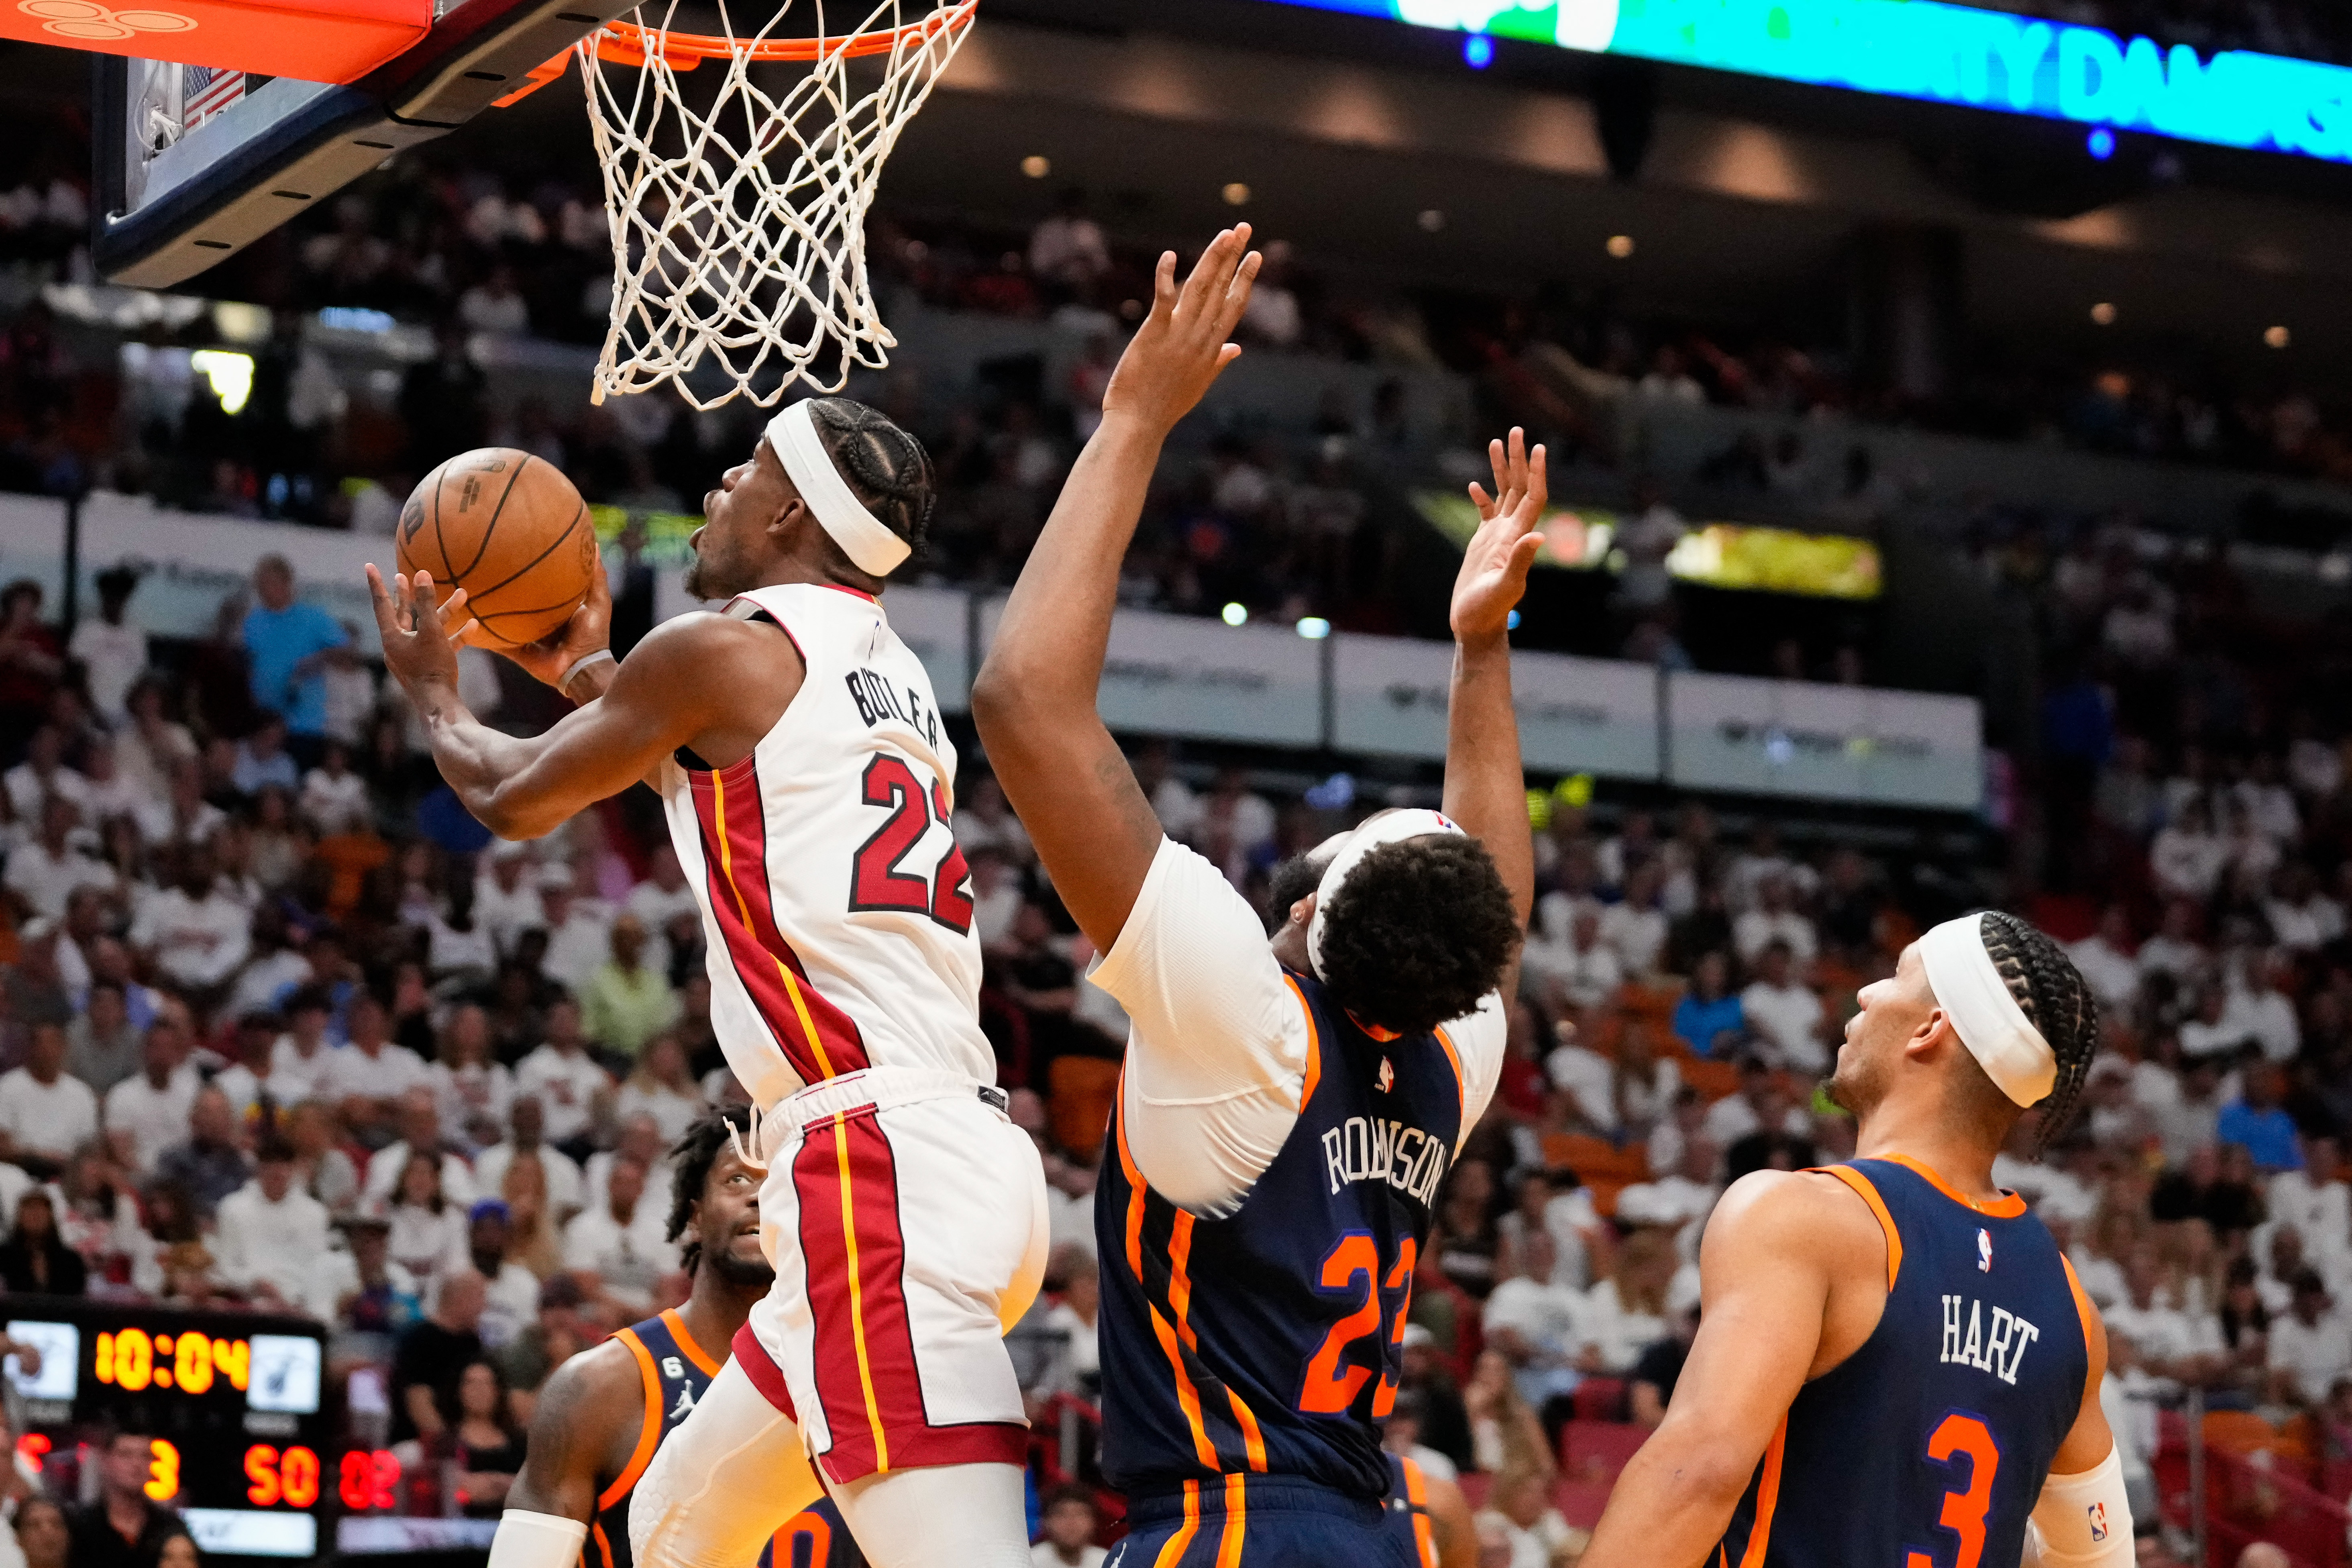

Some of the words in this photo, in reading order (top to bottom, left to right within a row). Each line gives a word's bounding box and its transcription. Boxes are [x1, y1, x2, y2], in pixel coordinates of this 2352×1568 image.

[845, 667, 940, 758] BUTLER
[848, 752, 974, 938] 22
[95, 1327, 250, 1394] 10:04
[662, 1356, 684, 1379] 6
[1940, 1295, 2039, 1385] HART
[244, 1444, 320, 1508] 50
[1902, 1407, 2003, 1568] 3
